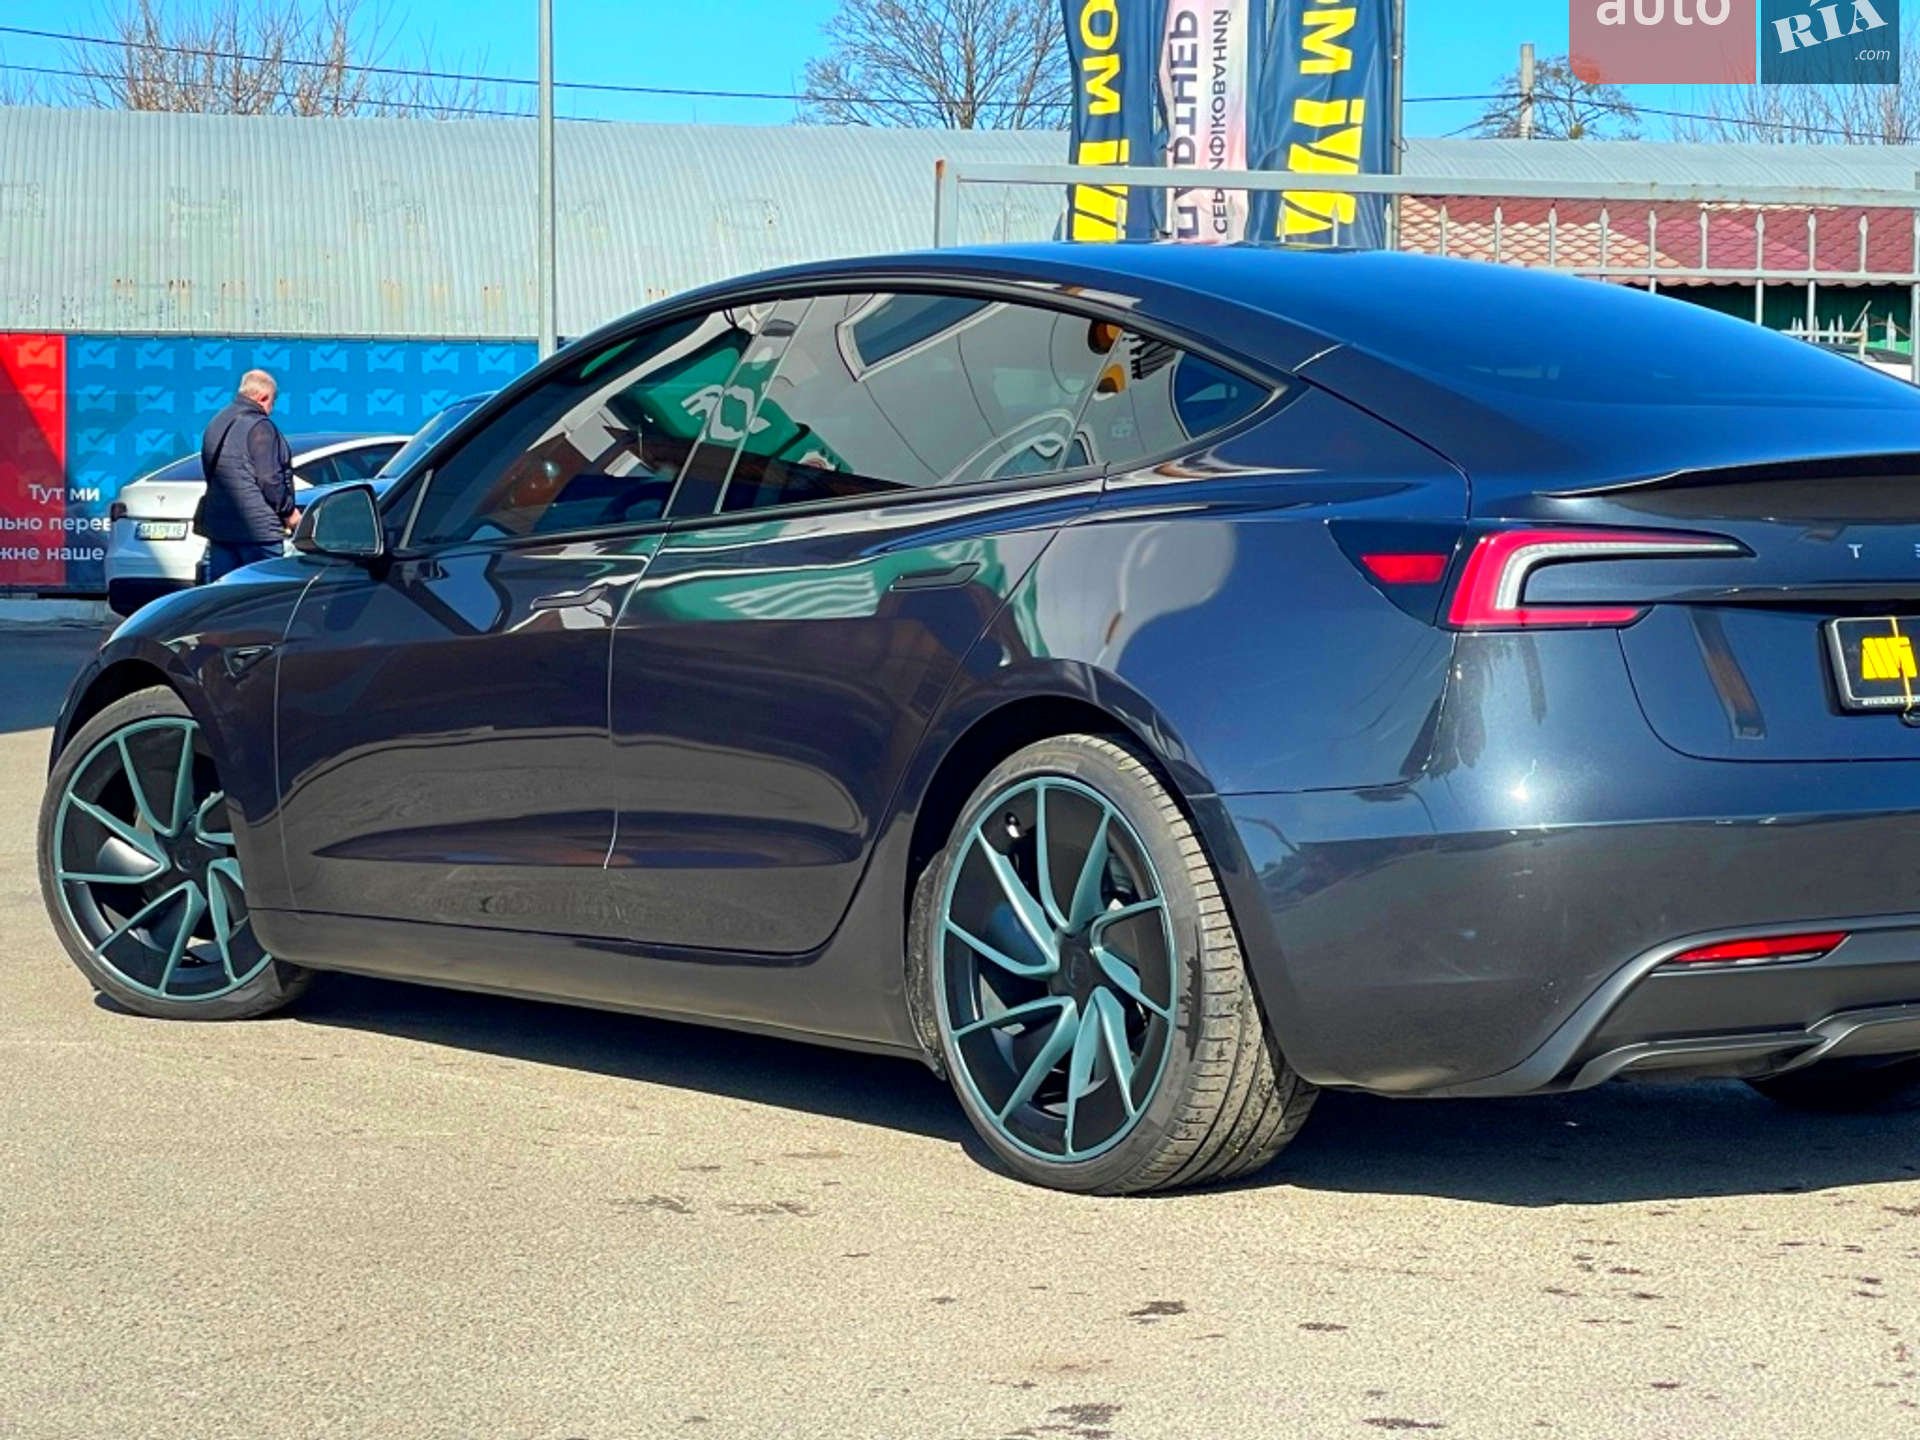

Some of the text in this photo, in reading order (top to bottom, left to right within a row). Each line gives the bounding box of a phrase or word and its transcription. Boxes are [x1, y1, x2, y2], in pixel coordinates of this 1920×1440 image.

[28, 483, 100, 504] Тут ми
[0, 517, 43, 530] ьно
[47, 547, 104, 560] наше
